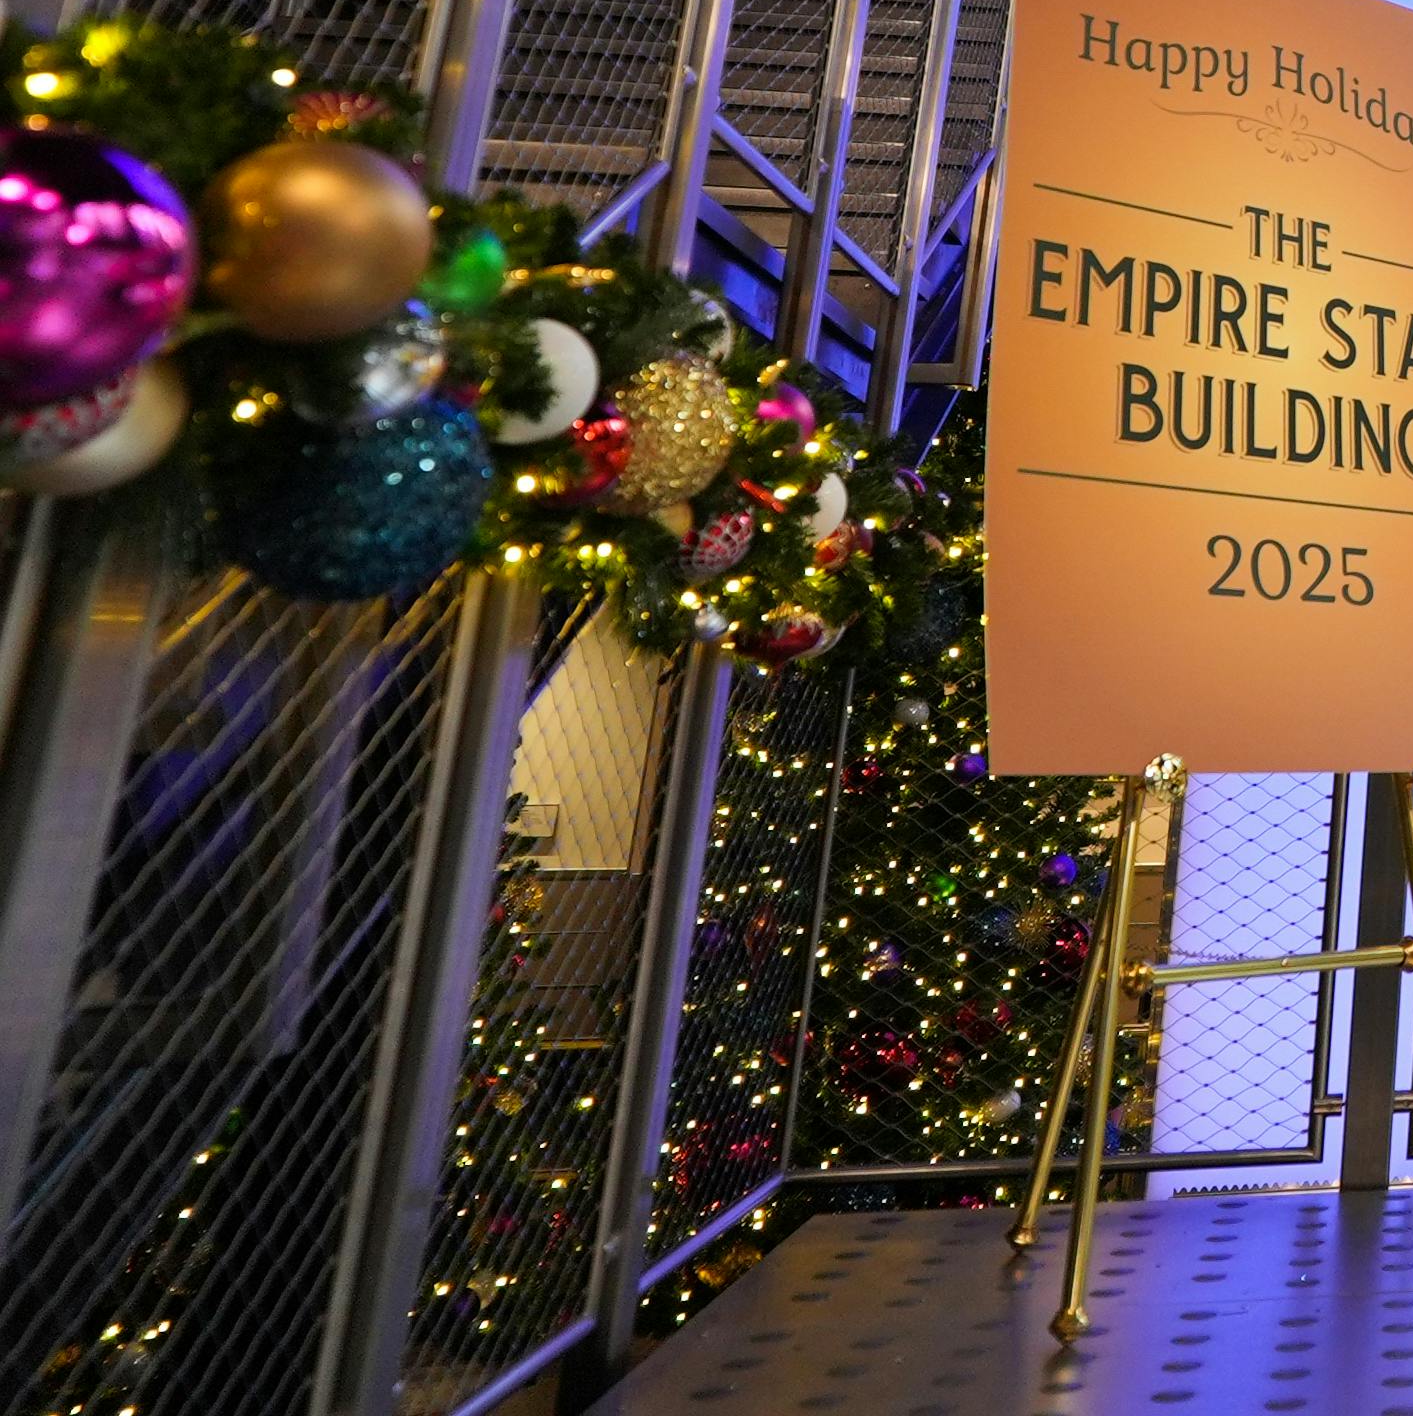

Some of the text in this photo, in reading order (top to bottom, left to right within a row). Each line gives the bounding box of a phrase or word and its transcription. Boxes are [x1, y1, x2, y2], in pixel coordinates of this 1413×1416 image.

[1077, 11, 1250, 97] Happy
[1243, 204, 1333, 273] THE
[1027, 237, 1292, 360] EMPIRE
[1205, 533, 1376, 608] 2025
